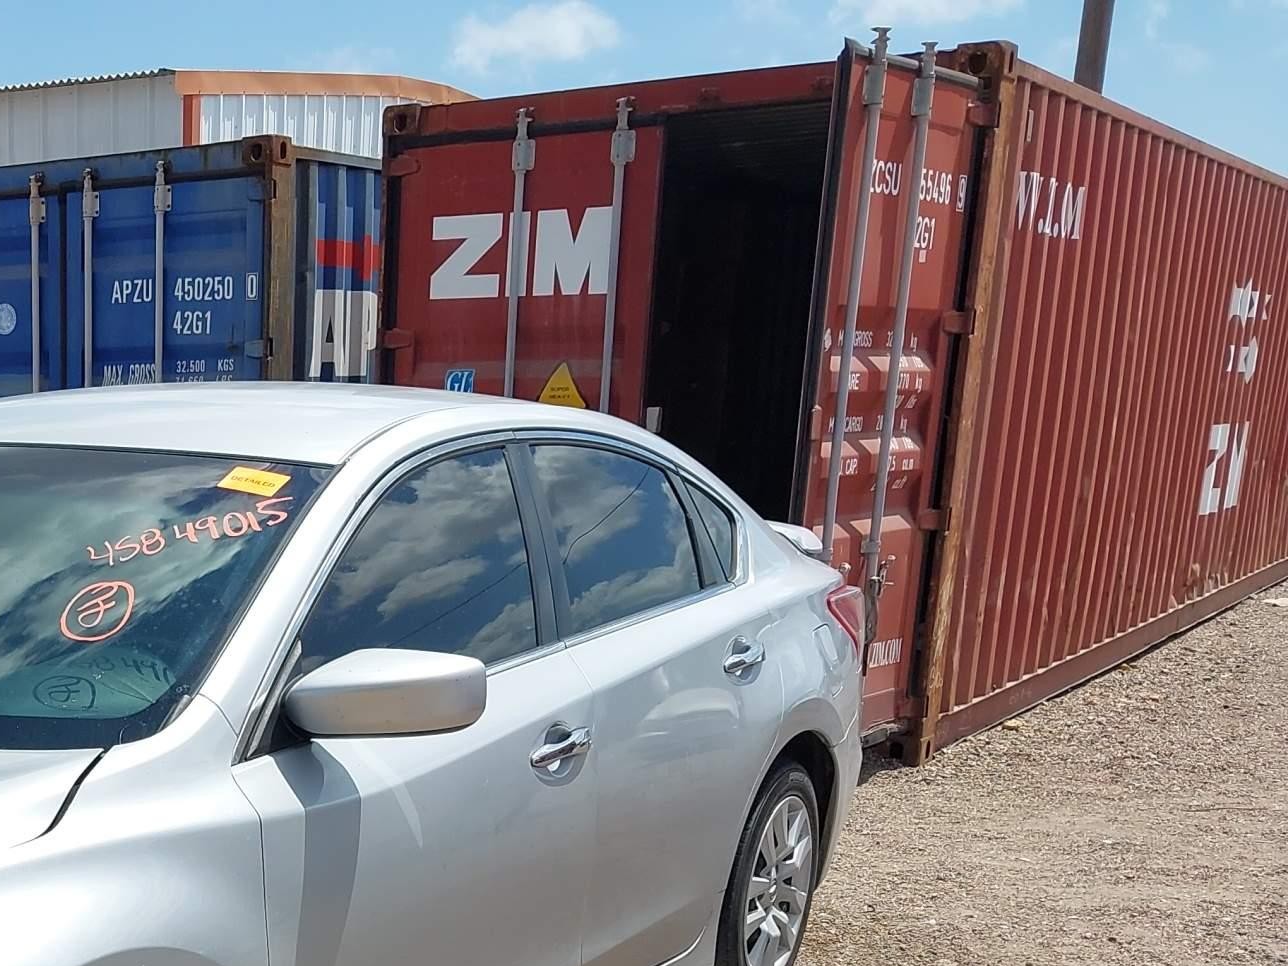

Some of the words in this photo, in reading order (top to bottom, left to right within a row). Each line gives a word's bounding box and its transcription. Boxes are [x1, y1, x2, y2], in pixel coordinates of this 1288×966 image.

[919, 168, 952, 205] 55496
[914, 216, 935, 250] 2G1
[430, 206, 612, 300] ZIM
[112, 279, 152, 304] APZU
[174, 276, 233, 301] 450250
[248, 274, 257, 298] 0
[173, 310, 211, 335] 42G1
[309, 289, 378, 377] AP
[128, 363, 156, 385] GROSS
[176, 360, 206, 373] 32.500
[217, 359, 234, 371] KGS
[848, 374, 861, 390] ARE
